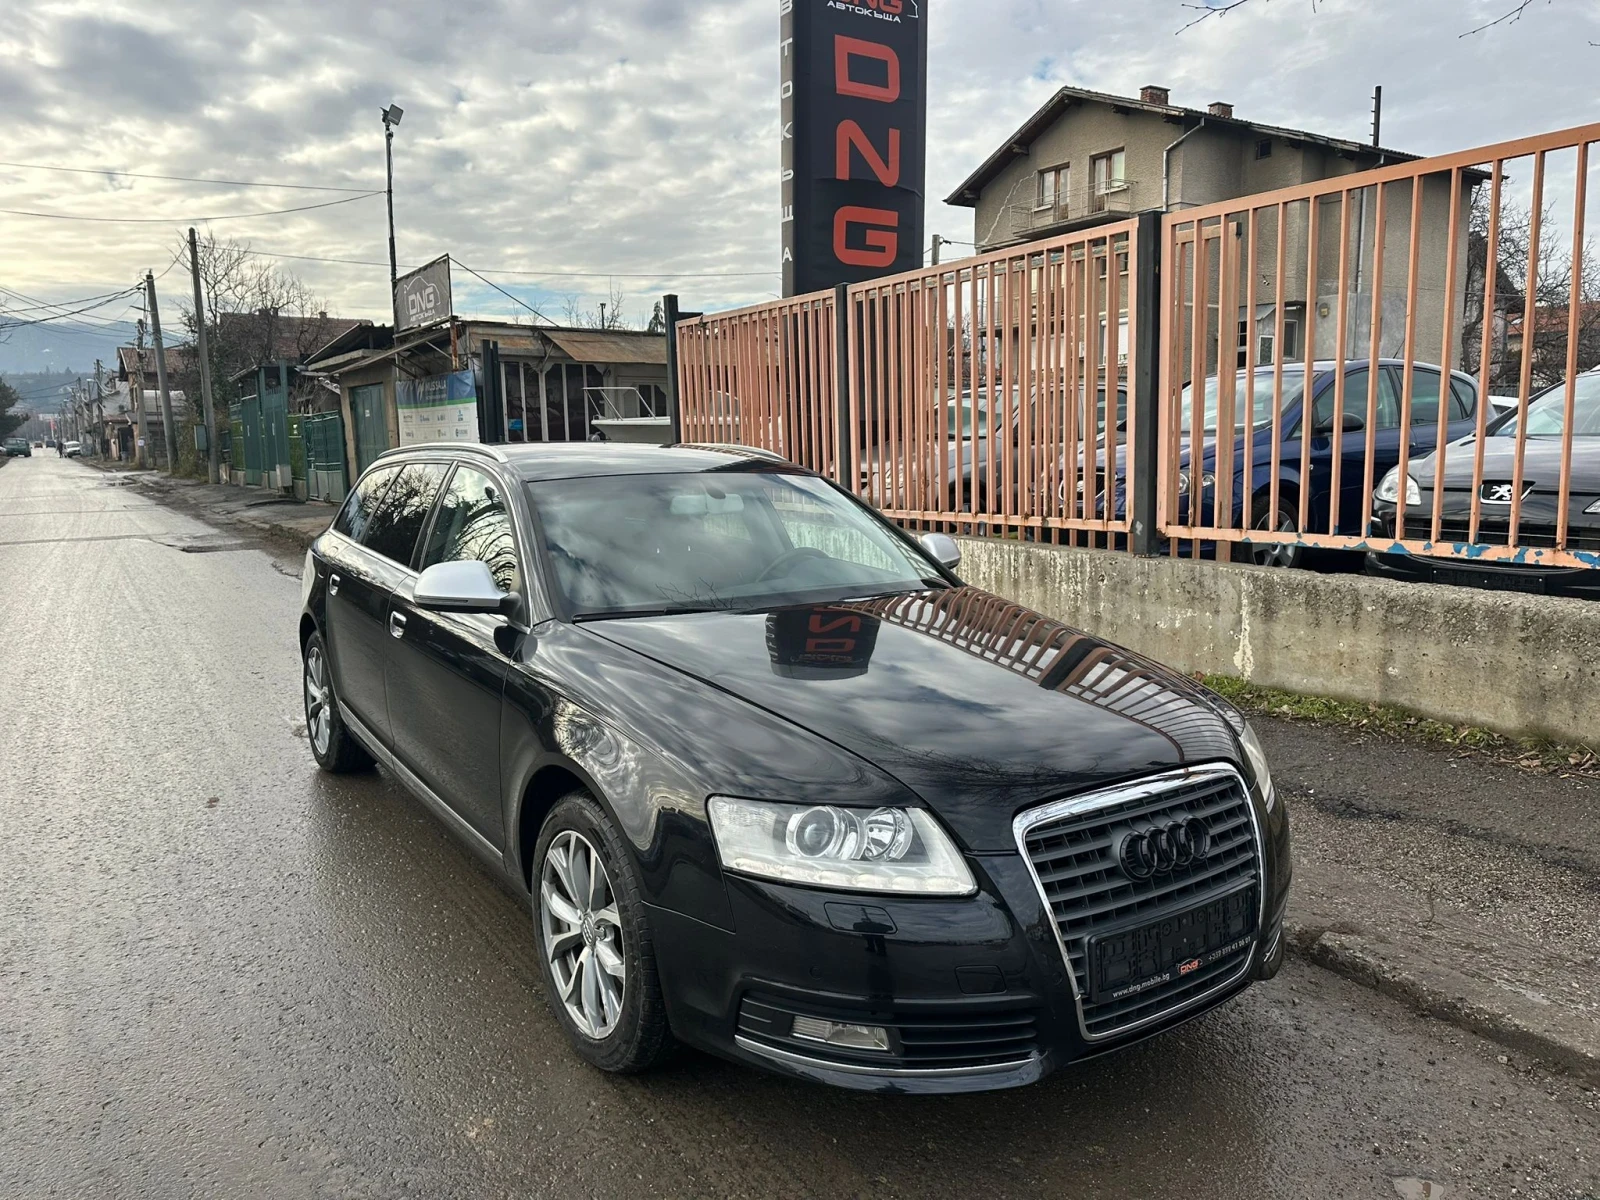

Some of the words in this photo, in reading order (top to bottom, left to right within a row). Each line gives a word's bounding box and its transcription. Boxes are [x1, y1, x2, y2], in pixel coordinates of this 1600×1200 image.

[826, 0, 902, 23] АВТОКЪЩА
[833, 33, 901, 268] DNG
[408, 286, 434, 315] DNG
[1112, 972, 1170, 998] www.dng.mobile.bg
